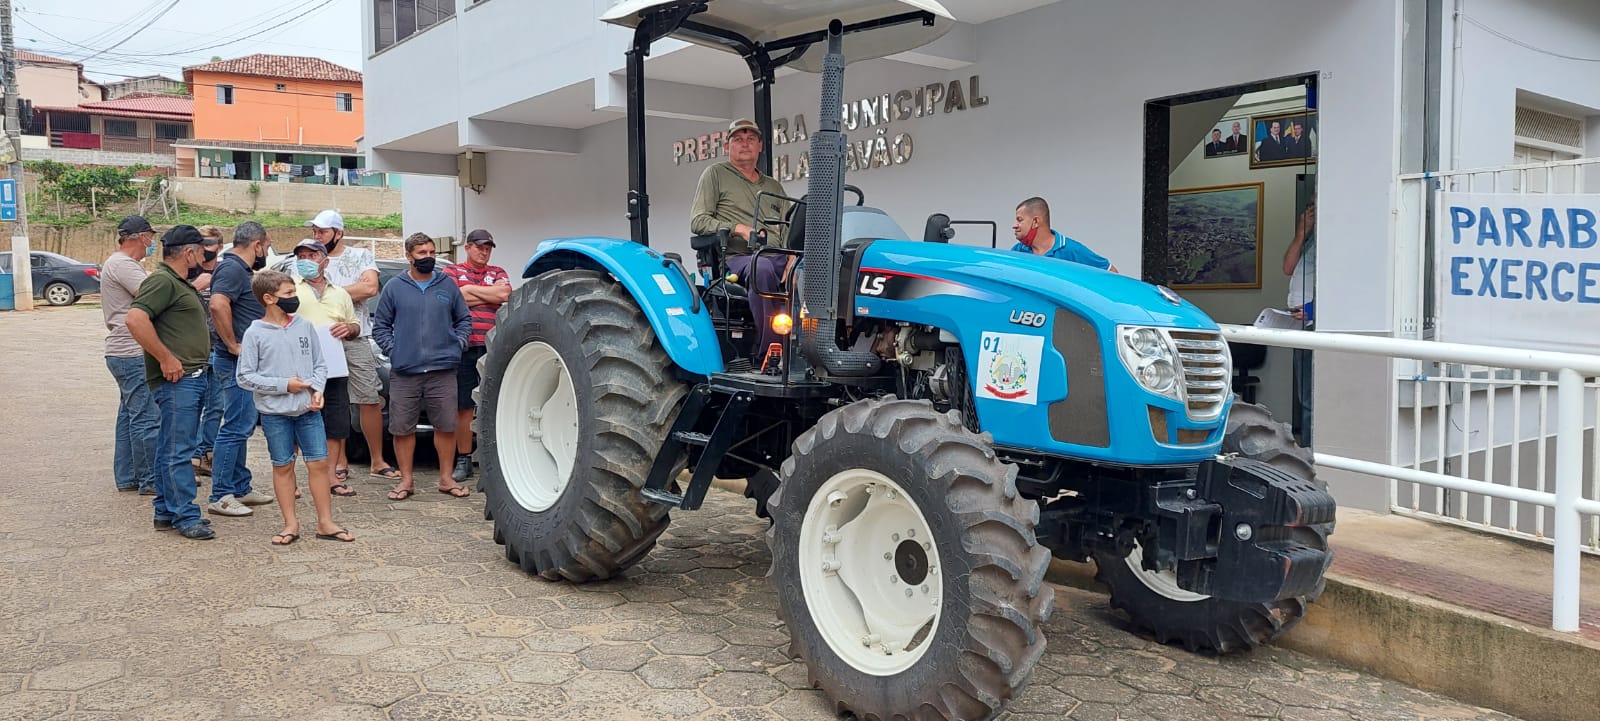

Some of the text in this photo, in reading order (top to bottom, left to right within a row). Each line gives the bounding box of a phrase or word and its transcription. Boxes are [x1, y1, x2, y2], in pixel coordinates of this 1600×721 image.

[673, 74, 989, 166] PREFRA UNICIPAL
[773, 127, 914, 182] ILA AVÃO
[859, 275, 887, 296] LS
[1450, 256, 1600, 304] EXERCE
[1009, 309, 1047, 328] U80
[299, 336, 309, 349] 58
[983, 336, 1000, 353] 01
